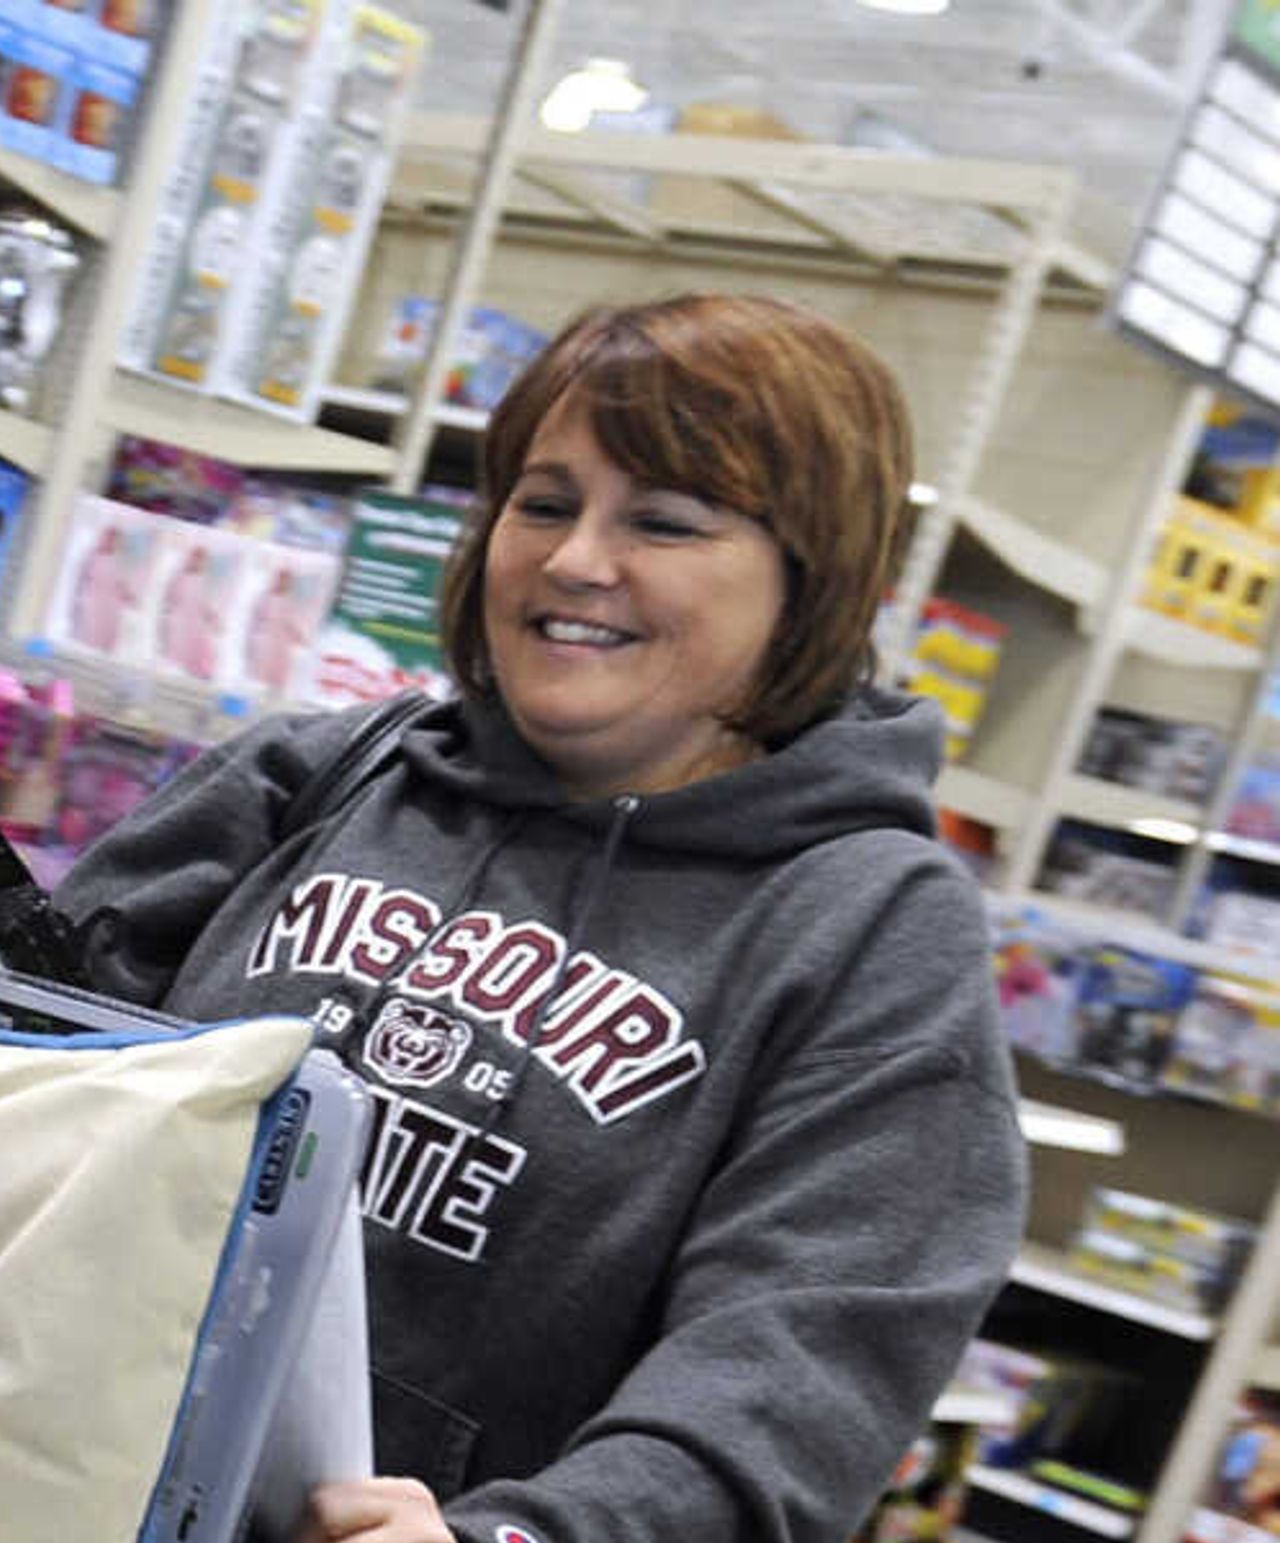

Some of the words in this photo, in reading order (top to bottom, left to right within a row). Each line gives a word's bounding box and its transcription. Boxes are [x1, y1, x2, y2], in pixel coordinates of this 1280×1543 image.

[246, 873, 707, 1126] MISSOURI
[311, 997, 355, 1034] 19
[463, 1061, 515, 1101] 05
